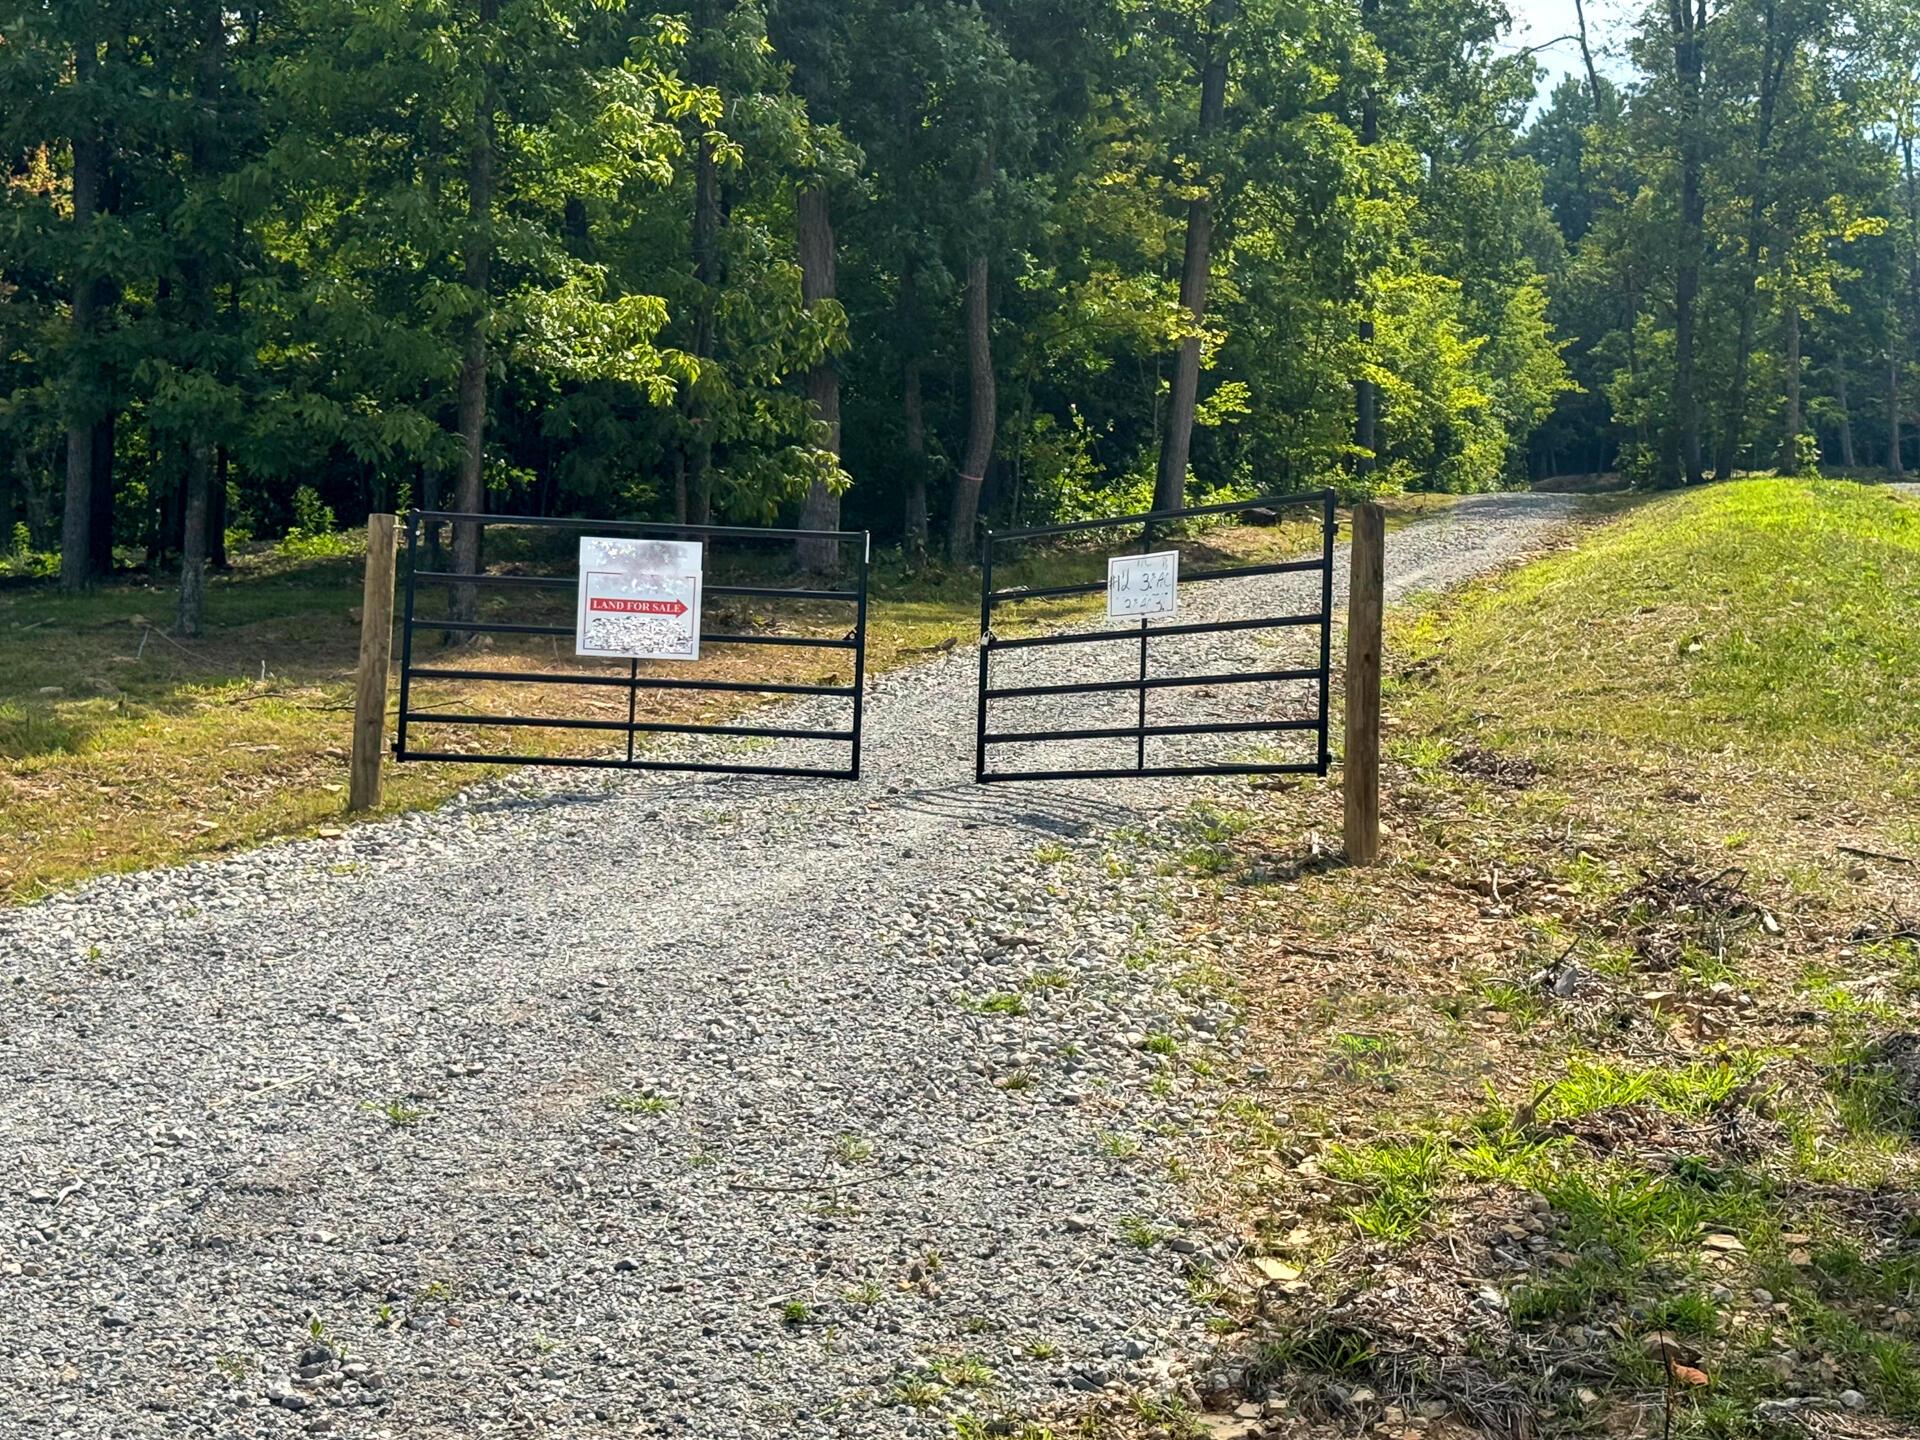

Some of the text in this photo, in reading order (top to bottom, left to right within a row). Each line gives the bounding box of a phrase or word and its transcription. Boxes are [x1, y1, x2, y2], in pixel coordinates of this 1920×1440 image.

[593, 600, 681, 613] LAND FOR SALE
